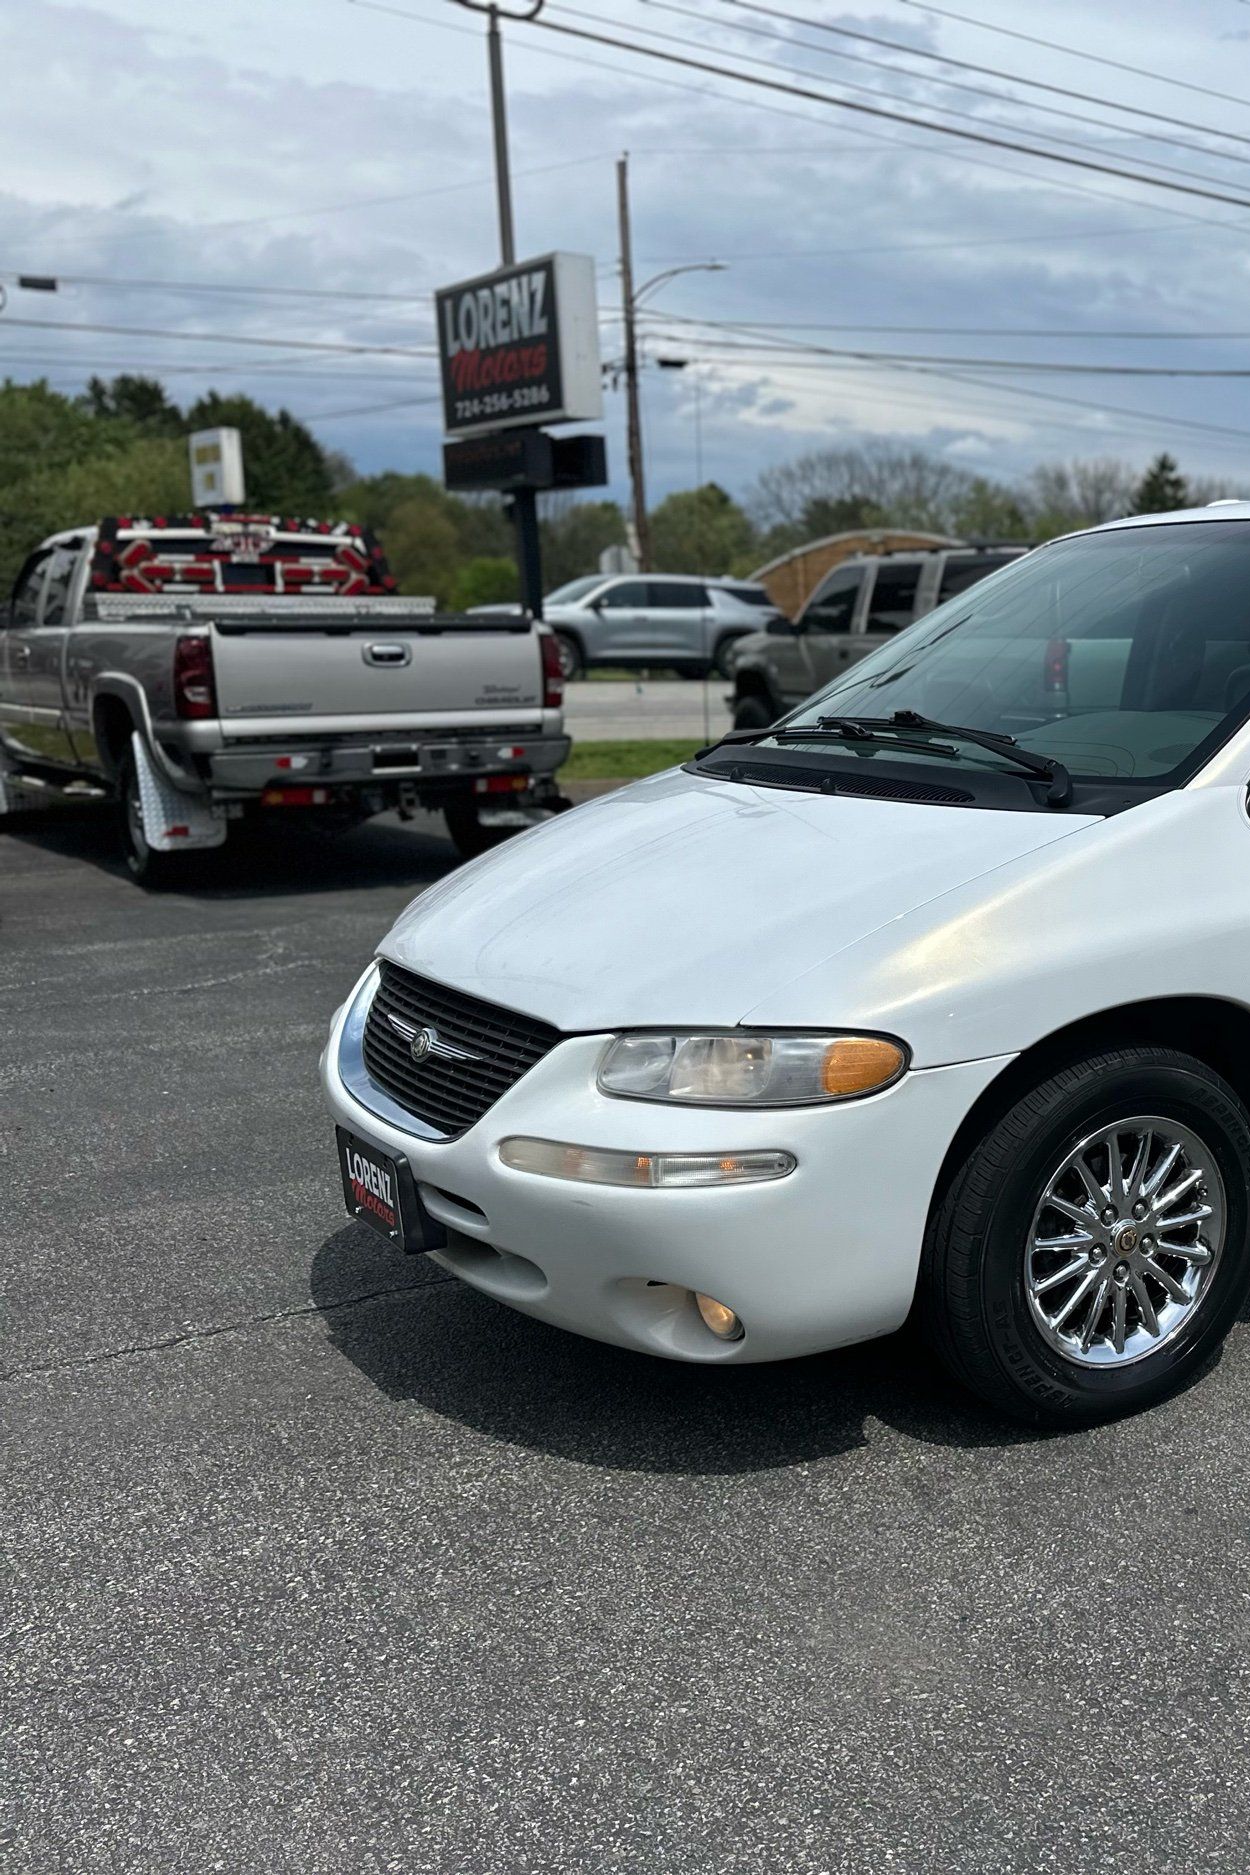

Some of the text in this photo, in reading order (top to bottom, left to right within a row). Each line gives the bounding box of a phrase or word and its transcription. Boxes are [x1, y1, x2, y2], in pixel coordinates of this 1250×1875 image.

[444, 271, 548, 357] LORENZ
[450, 343, 547, 394] Motors
[345, 1147, 394, 1208] LORENZ
[351, 1178, 396, 1227] Motors
